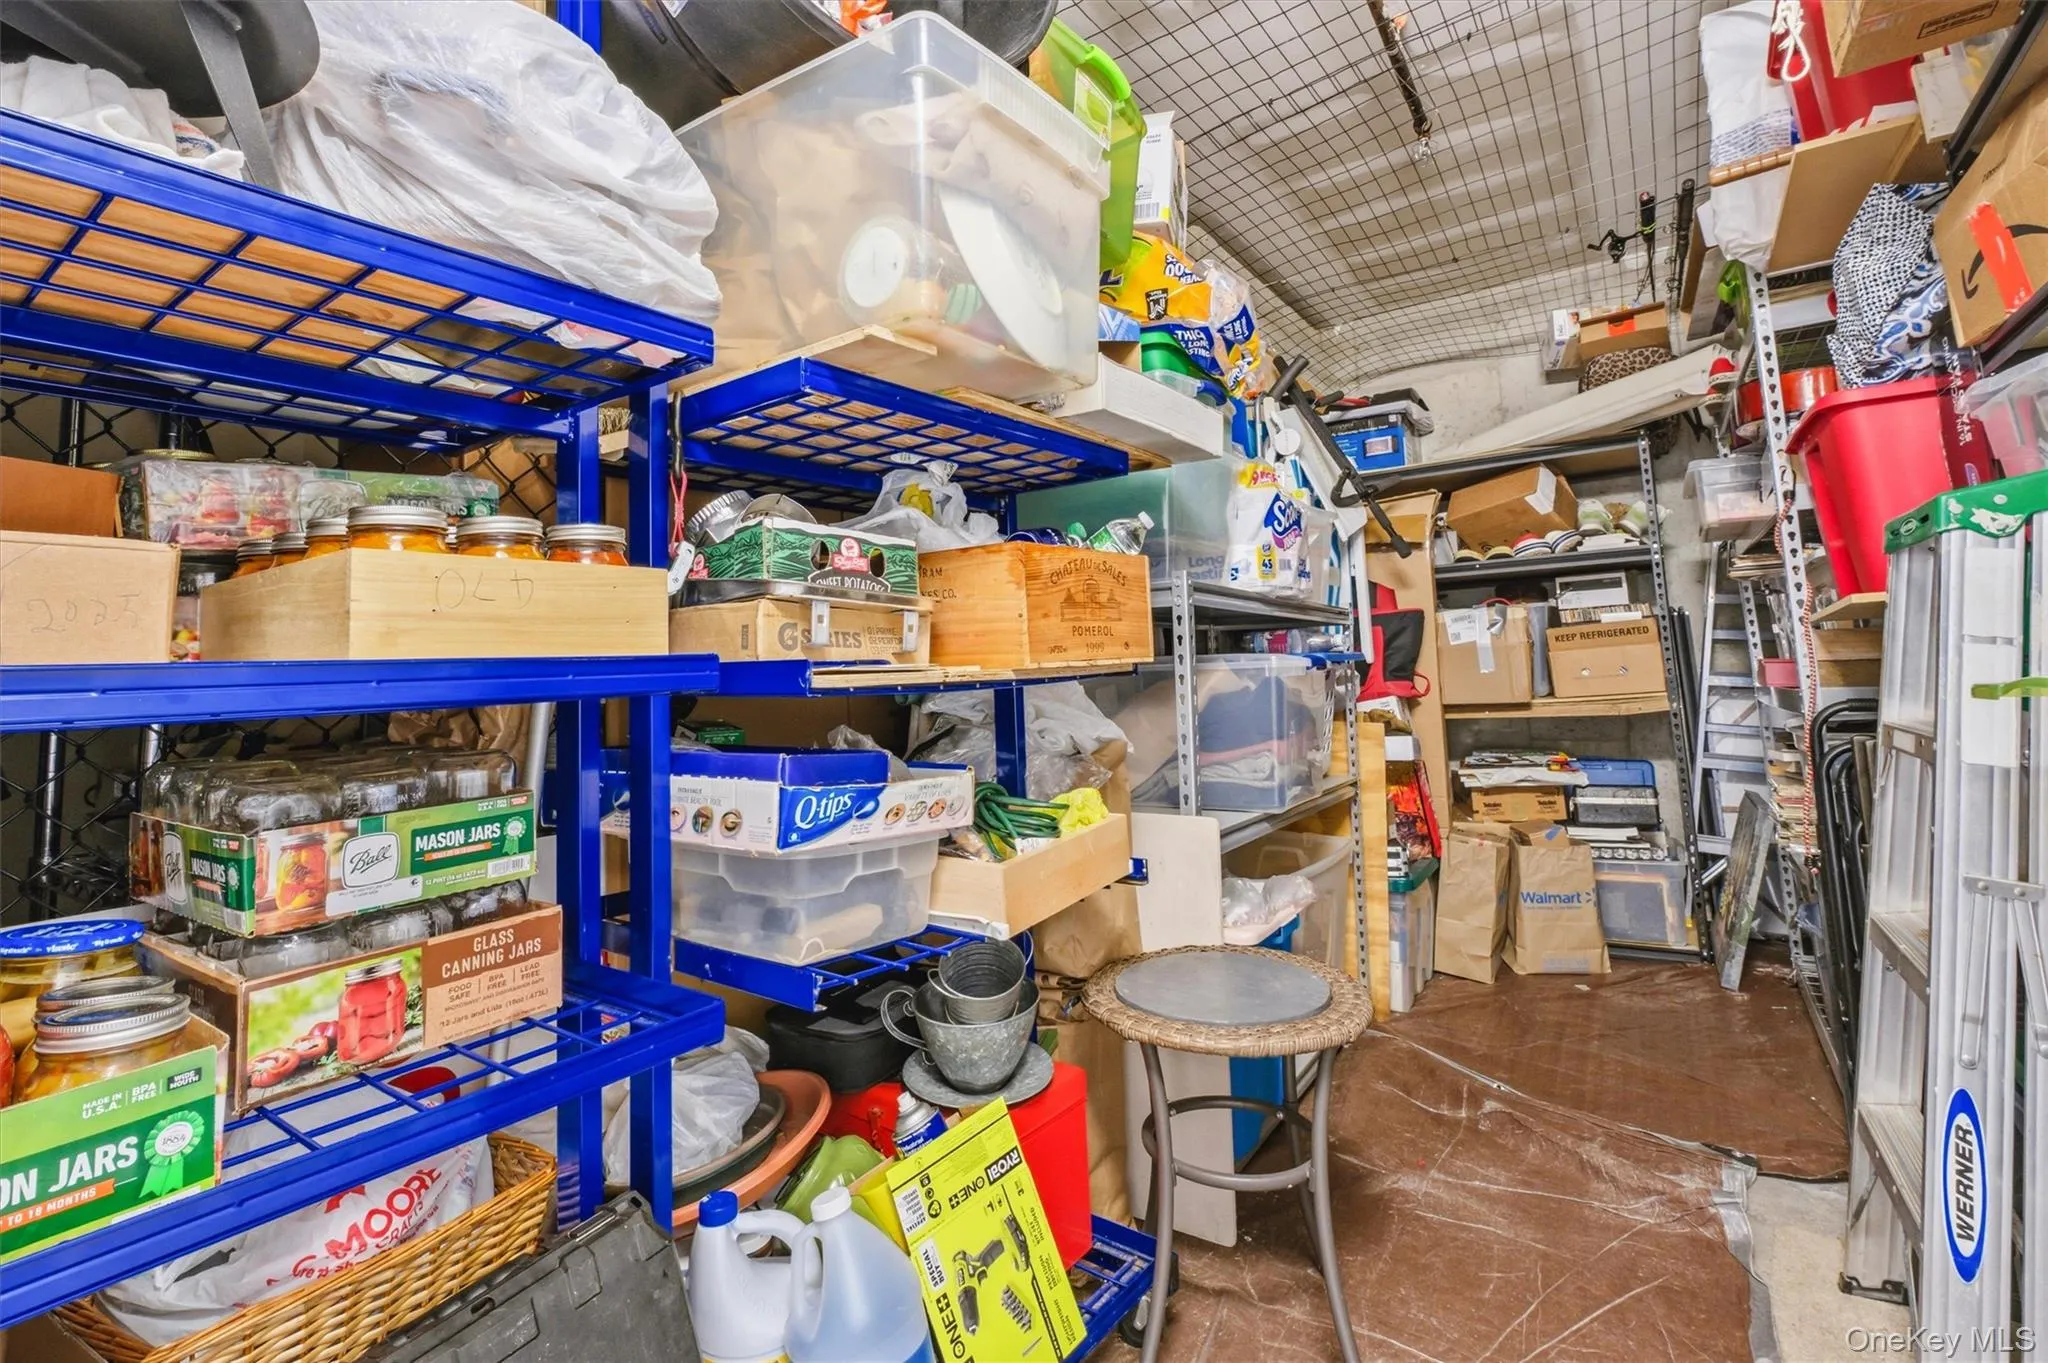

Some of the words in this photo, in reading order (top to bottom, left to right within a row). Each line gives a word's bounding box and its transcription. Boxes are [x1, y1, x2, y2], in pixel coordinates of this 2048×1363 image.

[1049, 557, 1093, 585] CHATEAU
[1261, 558, 1273, 569] 45
[800, 628, 863, 649] SIES
[1071, 625, 1115, 637] POMEROL
[1554, 633, 1578, 643] KEEP
[1579, 625, 1650, 640] REFRIGERATED
[414, 830, 465, 853] MASON
[468, 822, 501, 843] JARS
[350, 844, 393, 875] Ball
[1520, 891, 1582, 904] Walmart
[474, 928, 515, 952] GLASS
[441, 949, 504, 979] CANNING
[508, 937, 542, 960] JARS
[169, 1075, 199, 1090] MOUTH
[173, 1070, 196, 1083] WIDE
[131, 1091, 157, 1104] FREE
[132, 1081, 157, 1097] BPA
[82, 1096, 111, 1111] MADE
[111, 1092, 123, 1102] IN
[82, 1102, 122, 1120] U.S.A.
[48, 1135, 139, 1193] JARS
[986, 1148, 1020, 1183] RYOBI
[1954, 1123, 1975, 1243] WERNER
[7, 1212, 23, 1227] TO
[28, 1207, 42, 1219] 18
[46, 1187, 97, 1213] MONTHS
[921, 1248, 940, 1288] SPECIAL
